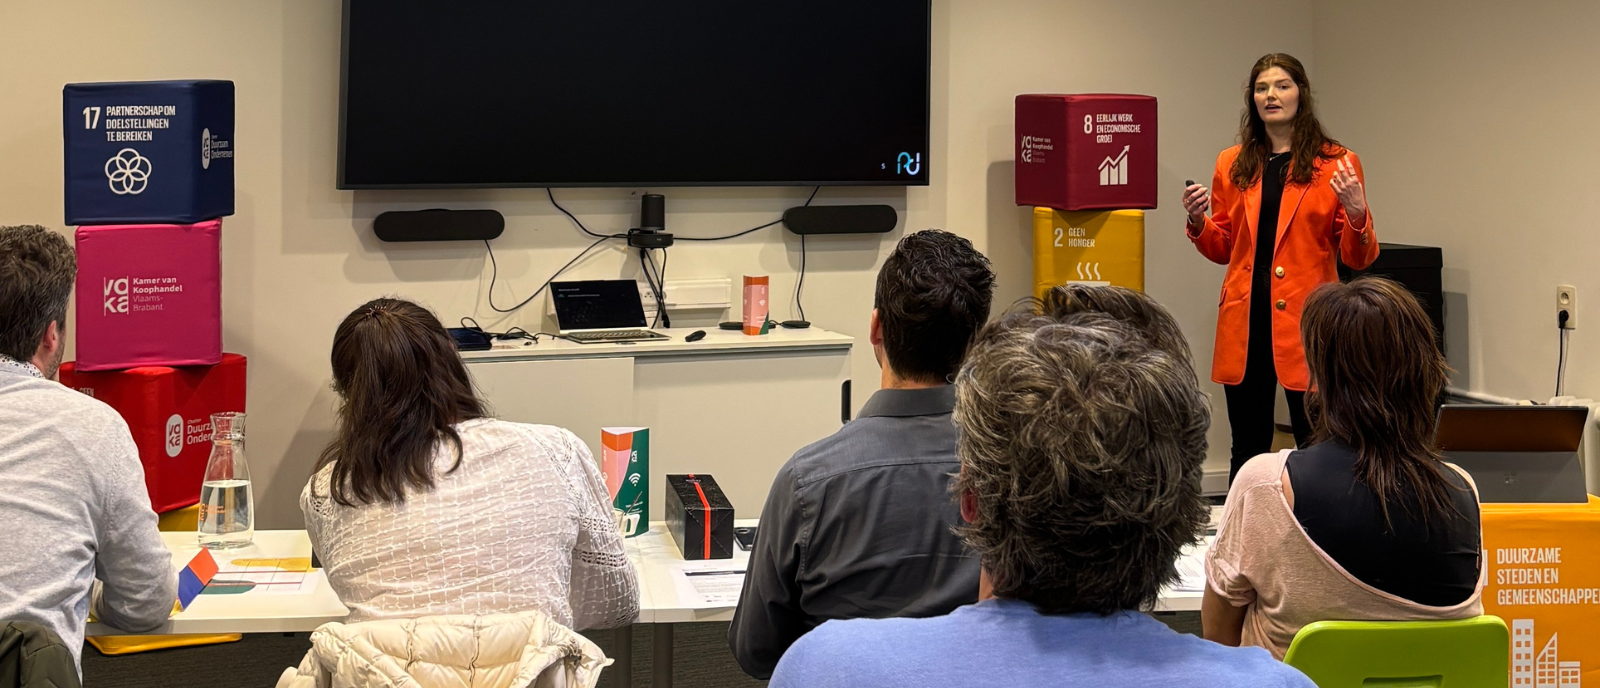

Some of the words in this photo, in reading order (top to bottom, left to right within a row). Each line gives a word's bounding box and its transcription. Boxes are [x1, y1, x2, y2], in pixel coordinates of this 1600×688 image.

[106, 105, 163, 117] PARTNERSCHAP
[163, 105, 176, 116] OM
[82, 106, 101, 130] 17
[106, 118, 169, 129] DOELSTELLINGEN
[1083, 114, 1093, 134] 8
[1096, 113, 1118, 123] EERLIJK
[1118, 113, 1133, 122] WERK
[1096, 124, 1104, 134] EN
[1103, 123, 1141, 133] ECONOMISCHE
[106, 131, 116, 142] TE
[116, 130, 153, 142] BEREIKEN
[1096, 134, 1113, 144] GROEI
[1053, 227, 1064, 248] 2
[1068, 227, 1086, 237] GEEN
[1068, 238, 1096, 248] HONGER
[132, 277, 160, 285] Kamer
[132, 284, 183, 295] Koophandel
[132, 303, 164, 312] Brabant
[187, 422, 212, 435] Duurz
[186, 431, 212, 445] Onder
[1496, 547, 1562, 565] DUURZAME
[1496, 568, 1542, 585] STEDEN
[1543, 567, 1559, 584] EN
[1497, 587, 1600, 606] GEMEENSCHAPPE
